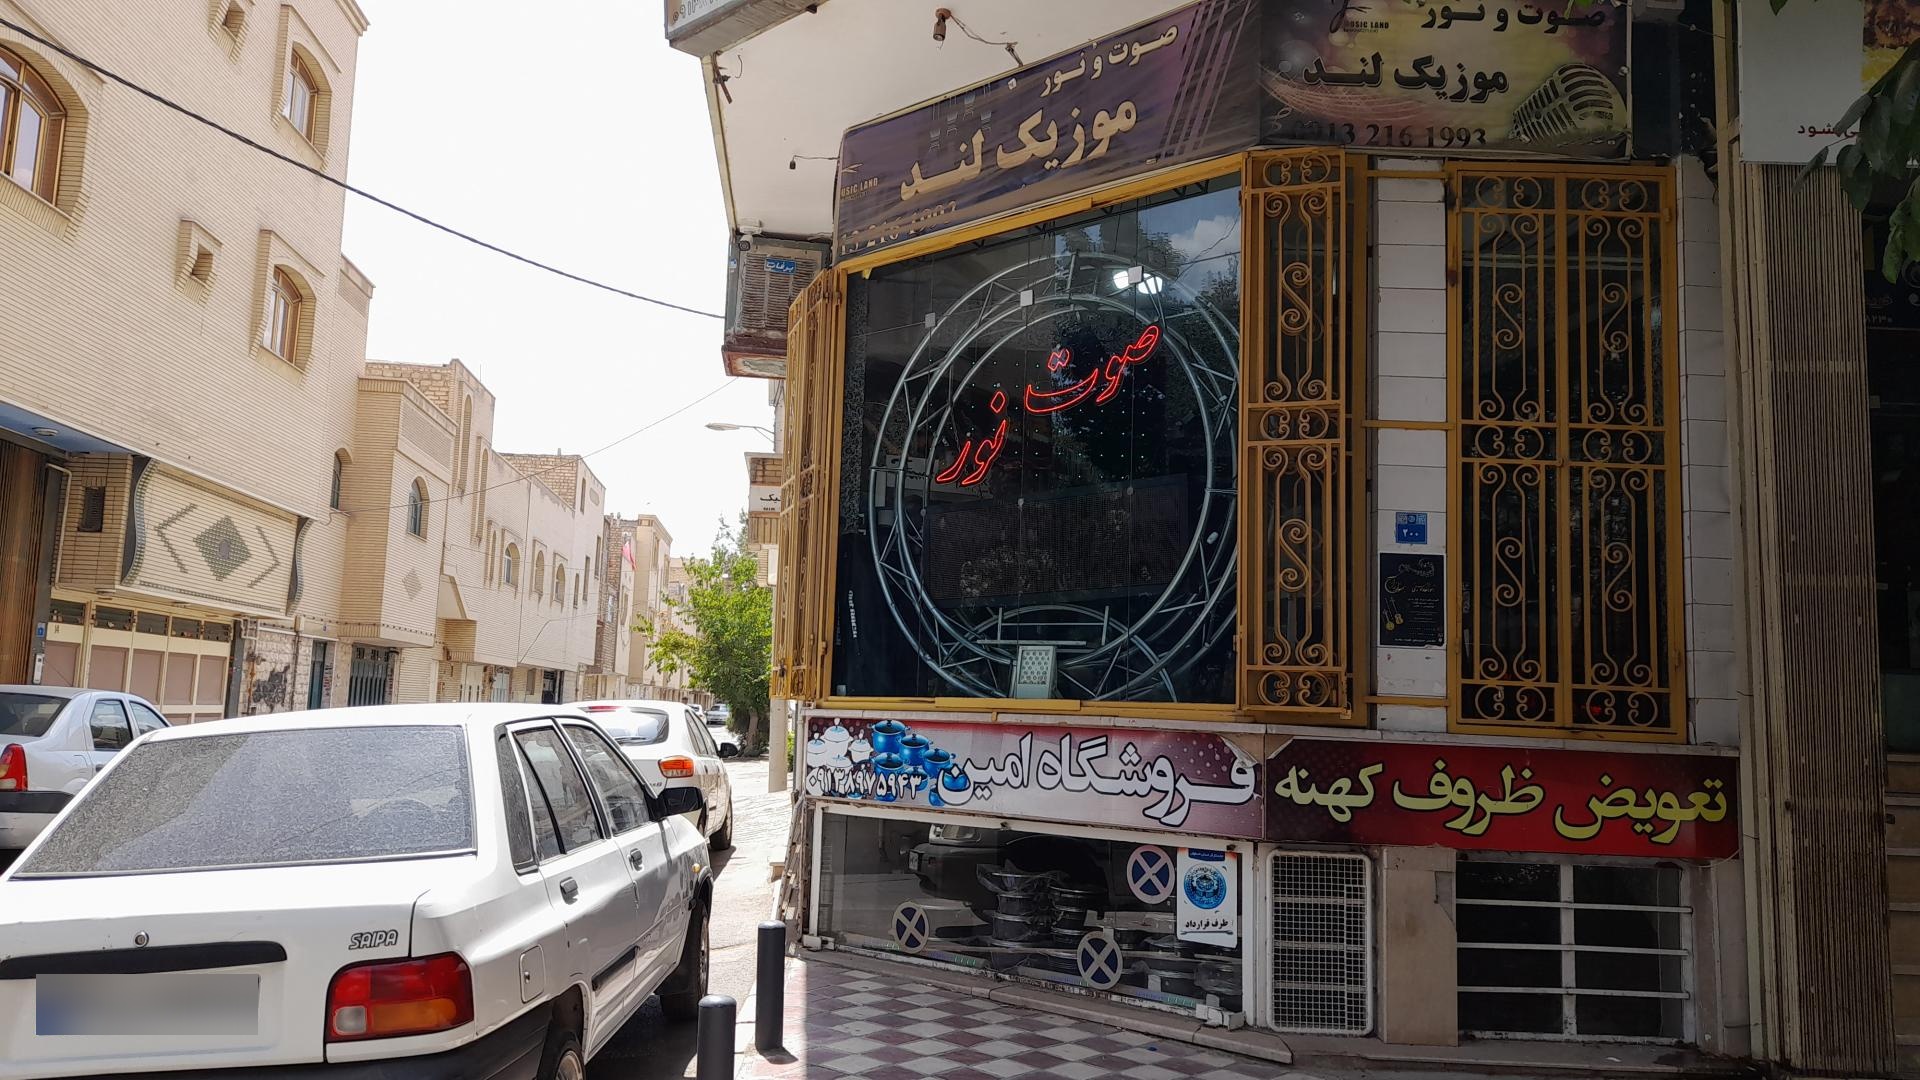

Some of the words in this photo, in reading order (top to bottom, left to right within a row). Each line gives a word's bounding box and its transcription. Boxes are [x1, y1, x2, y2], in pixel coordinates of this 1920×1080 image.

[1370, 21, 1389, 29] LAND
[1493, 8, 1508, 32] و
[1517, 5, 1605, 33] صوت
[1108, 24, 1179, 66] صوت
[1040, 52, 1086, 98] نور
[1090, 54, 1104, 79] و
[1302, 52, 1383, 88] لند
[1393, 55, 1509, 104] موزیک
[996, 100, 1137, 170] موزیک
[1366, 124, 1412, 148] 216
[1426, 125, 1487, 148] 1993
[859, 177, 879, 191] LAND
[900, 128, 985, 201] لند
[1024, 324, 1160, 414] صوت
[935, 390, 1007, 486] نور
[1402, 528, 1419, 537] ۲۰۰
[937, 731, 1033, 806] امین
[1035, 732, 1257, 827] فروشگاه
[1273, 762, 1384, 823] کهنه
[1392, 758, 1545, 836] ظروف
[1553, 774, 1728, 844] تعویض
[348, 928, 399, 950] SAIPA
[1185, 918, 1210, 930] قرارداد
[1211, 918, 1228, 930] طرف
